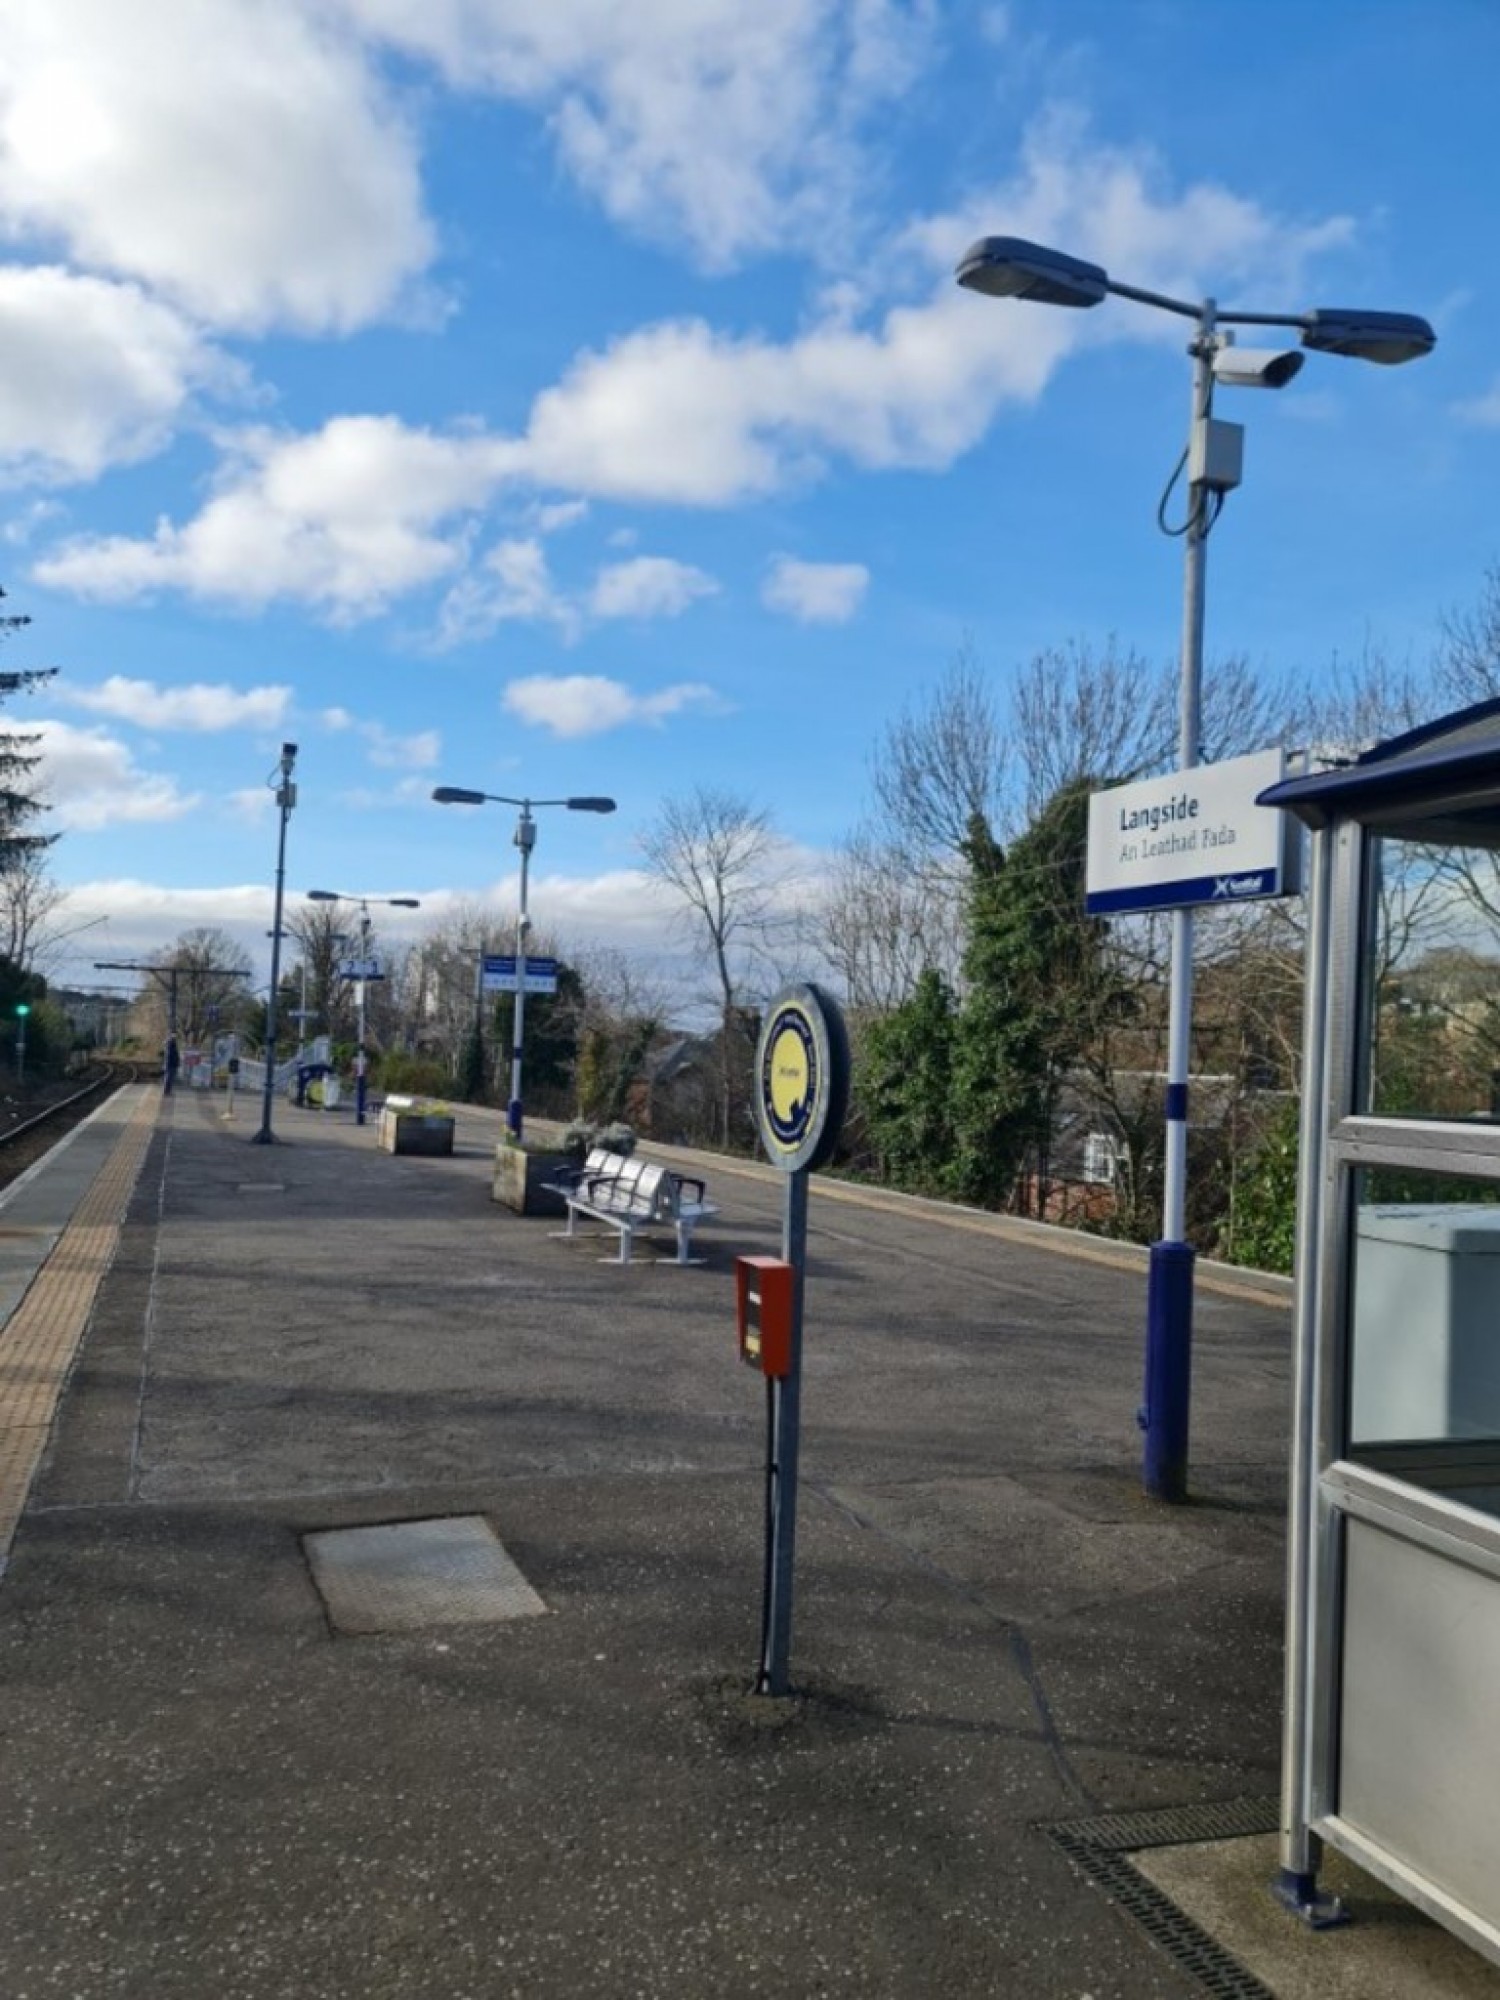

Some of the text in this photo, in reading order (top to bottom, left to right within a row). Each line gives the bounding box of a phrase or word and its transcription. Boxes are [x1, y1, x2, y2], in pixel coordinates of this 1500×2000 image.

[1120, 794, 1198, 832] Langside
[1119, 825, 1237, 862] An Leathad Fada
